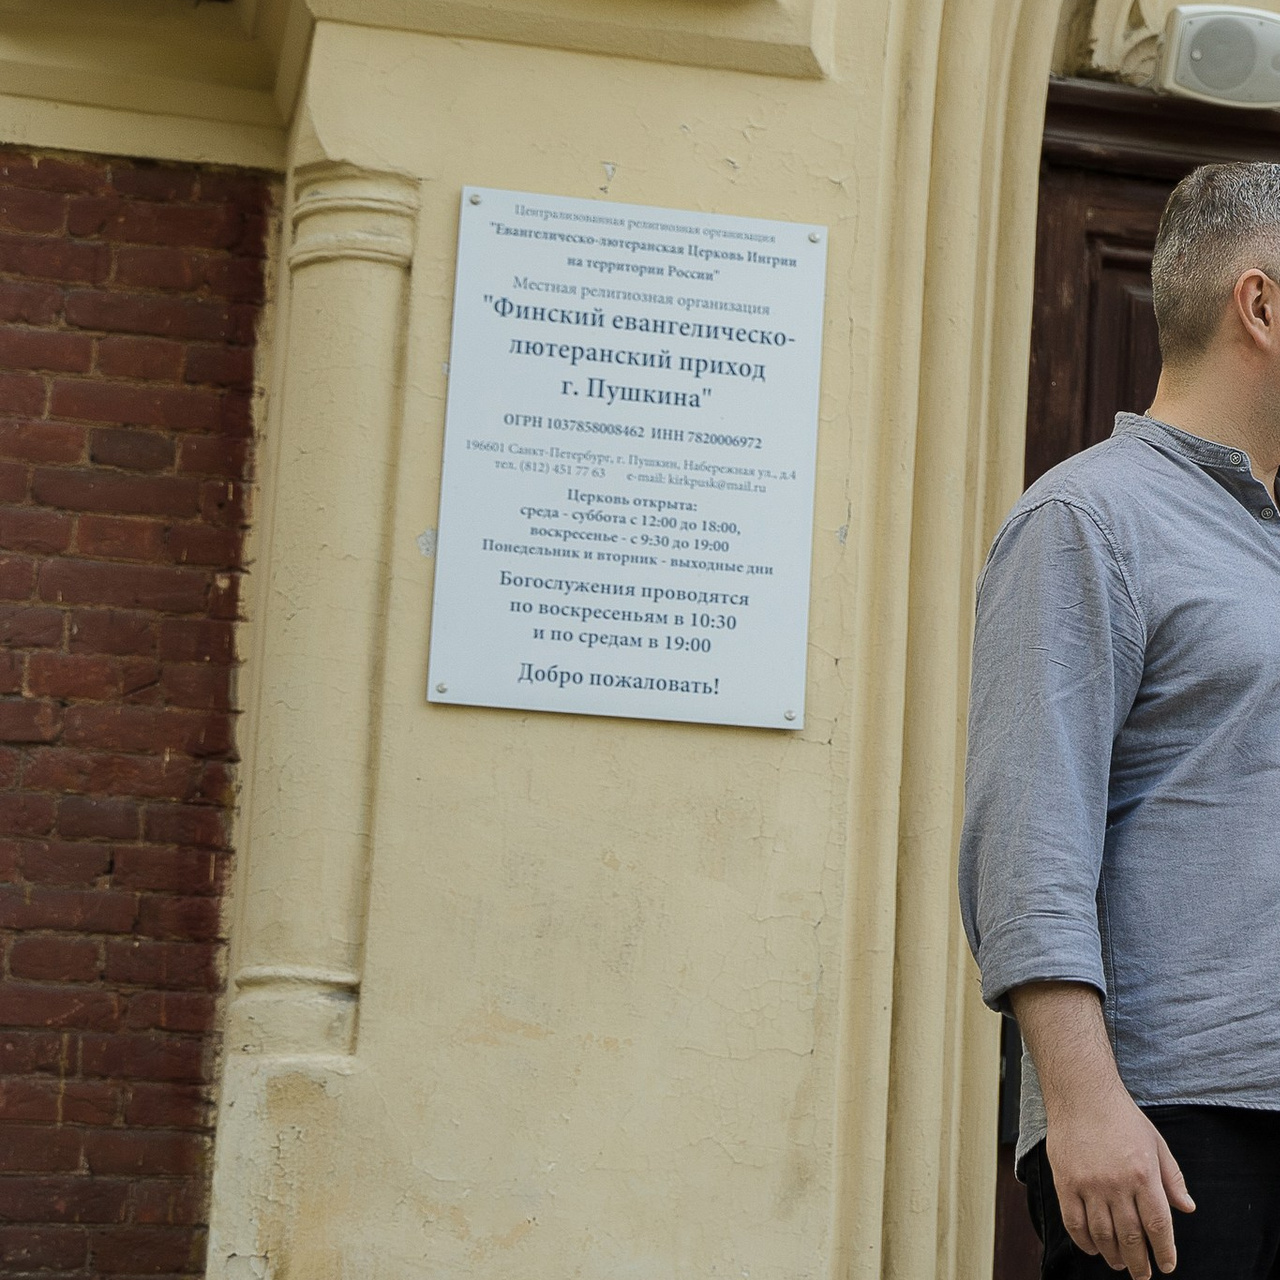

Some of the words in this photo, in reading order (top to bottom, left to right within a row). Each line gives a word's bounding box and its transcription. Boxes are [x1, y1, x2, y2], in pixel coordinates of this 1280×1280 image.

[514, 203, 626, 227] Централизованная
[627, 219, 701, 235] религиозная
[702, 228, 776, 244] организация
[490, 221, 685, 255] "Евангелическо-лютеранская
[687, 243, 745, 262] Церковь
[747, 250, 797, 269] Ингрии
[567, 257, 584, 268] на
[586, 259, 665, 278] территории
[667, 264, 720, 282] России"
[512, 275, 577, 296] Местная
[580, 286, 674, 306] религиозная
[676, 296, 771, 316] организация
[483, 294, 605, 328] "Финский
[611, 315, 796, 347] евангелическо-
[509, 339, 672, 370] лютеранский
[679, 356, 766, 382] приход
[561, 380, 579, 396] г.
[587, 377, 712, 408] Пушкина"
[503, 413, 543, 429] ОГРН
[547, 417, 645, 439] 1037858008462
[651, 427, 684, 442] ИНН
[687, 430, 762, 450] 7820006972
[466, 439, 505, 453] 196601
[507, 442, 615, 466] Санкт-Петербург,
[628, 453, 681, 471] Пушкин,
[683, 459, 756, 477] Набережная
[519, 460, 550, 475] (812)
[552, 463, 572, 476] 451
[575, 465, 590, 477] 77
[591, 467, 606, 479] 63
[567, 488, 630, 506] Церковь
[632, 497, 698, 512] открыта:
[519, 506, 560, 520] среда
[571, 509, 627, 525] суббота
[629, 516, 638, 526] с
[642, 514, 678, 529] 12:00
[679, 521, 698, 531] до
[702, 520, 741, 536] 18:00,
[529, 526, 619, 543] воскресенье
[629, 535, 638, 545] с
[640, 534, 670, 548] 9:30
[671, 539, 690, 550] до
[694, 538, 730, 553] 19:00
[482, 538, 580, 559] Понедельник
[583, 550, 593, 560] и
[596, 551, 658, 566] вторник
[670, 558, 745, 573] выходные
[746, 565, 774, 576] дни
[500, 570, 636, 597] Богослужения
[641, 586, 749, 606] проводятся
[510, 601, 534, 613] по
[538, 603, 668, 625] воскресеньям
[673, 614, 685, 626] в
[691, 612, 737, 630] 10:30
[533, 628, 545, 640] и
[550, 629, 574, 642] по
[578, 632, 643, 649] средам
[648, 637, 659, 649] в
[666, 635, 712, 653] 19:00
[517, 662, 584, 689] Добро
[589, 673, 720, 695] пожаловать!
